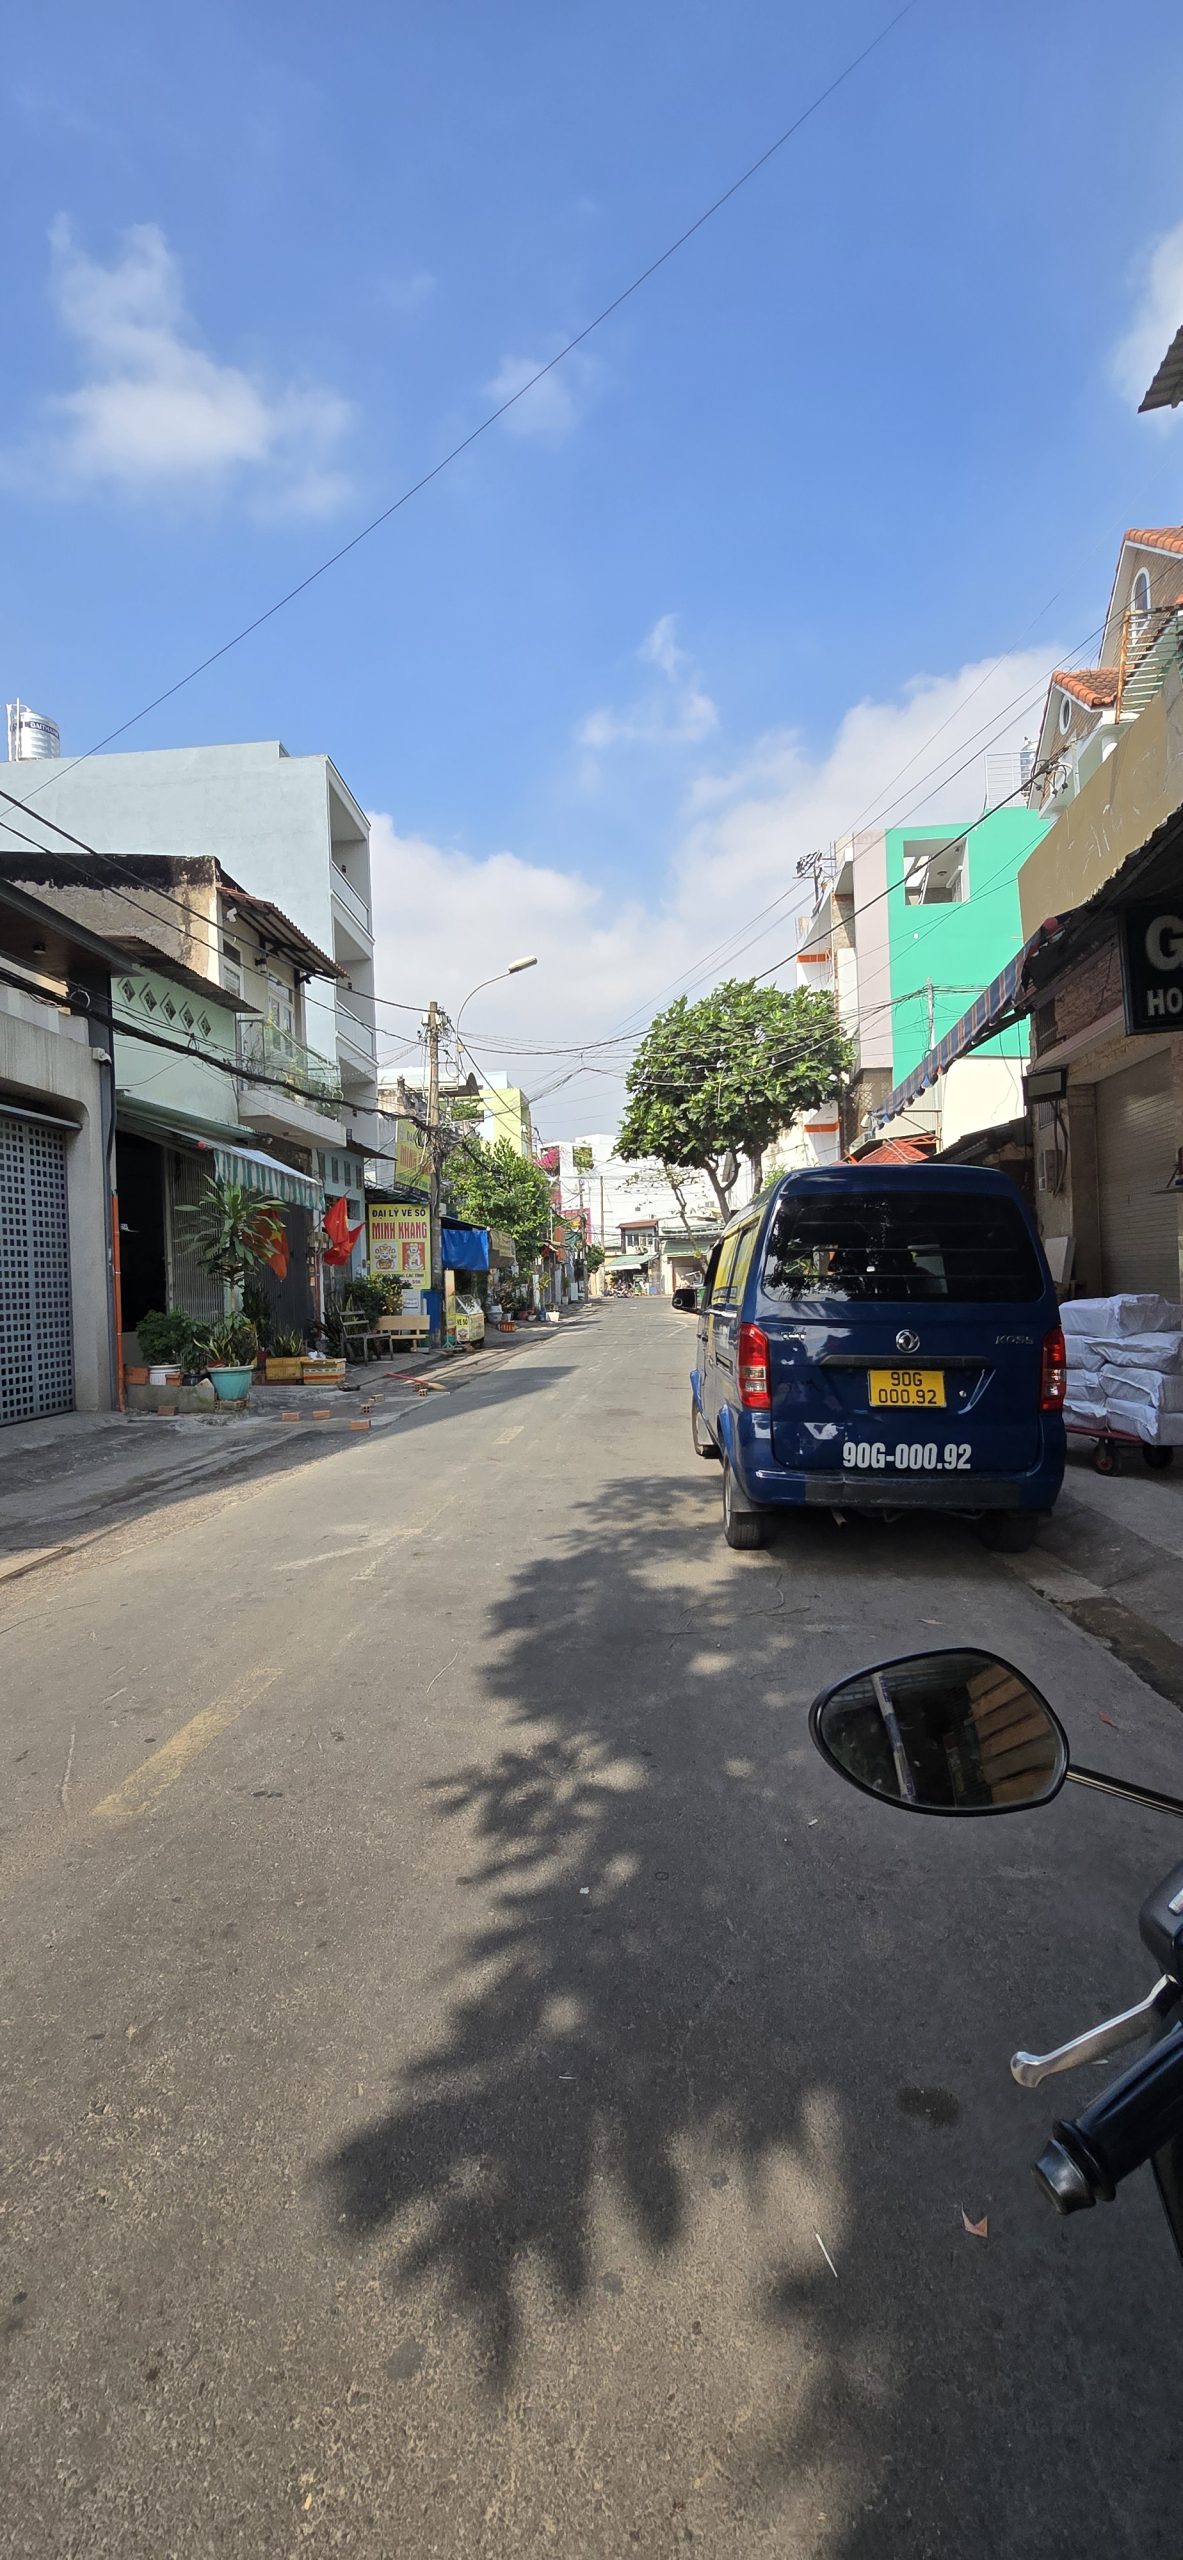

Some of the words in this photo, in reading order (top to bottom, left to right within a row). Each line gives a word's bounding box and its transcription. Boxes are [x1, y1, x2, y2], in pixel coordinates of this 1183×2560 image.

[372, 1209, 386, 1219] ĐẠI
[388, 1207, 399, 1217] LÝ
[372, 1222, 395, 1240] MINH
[398, 1221, 428, 1239] KHANG
[891, 1371, 923, 1387] 90G
[878, 1388, 937, 1405] 000.92
[842, 1441, 972, 1470] 90G-000.92
